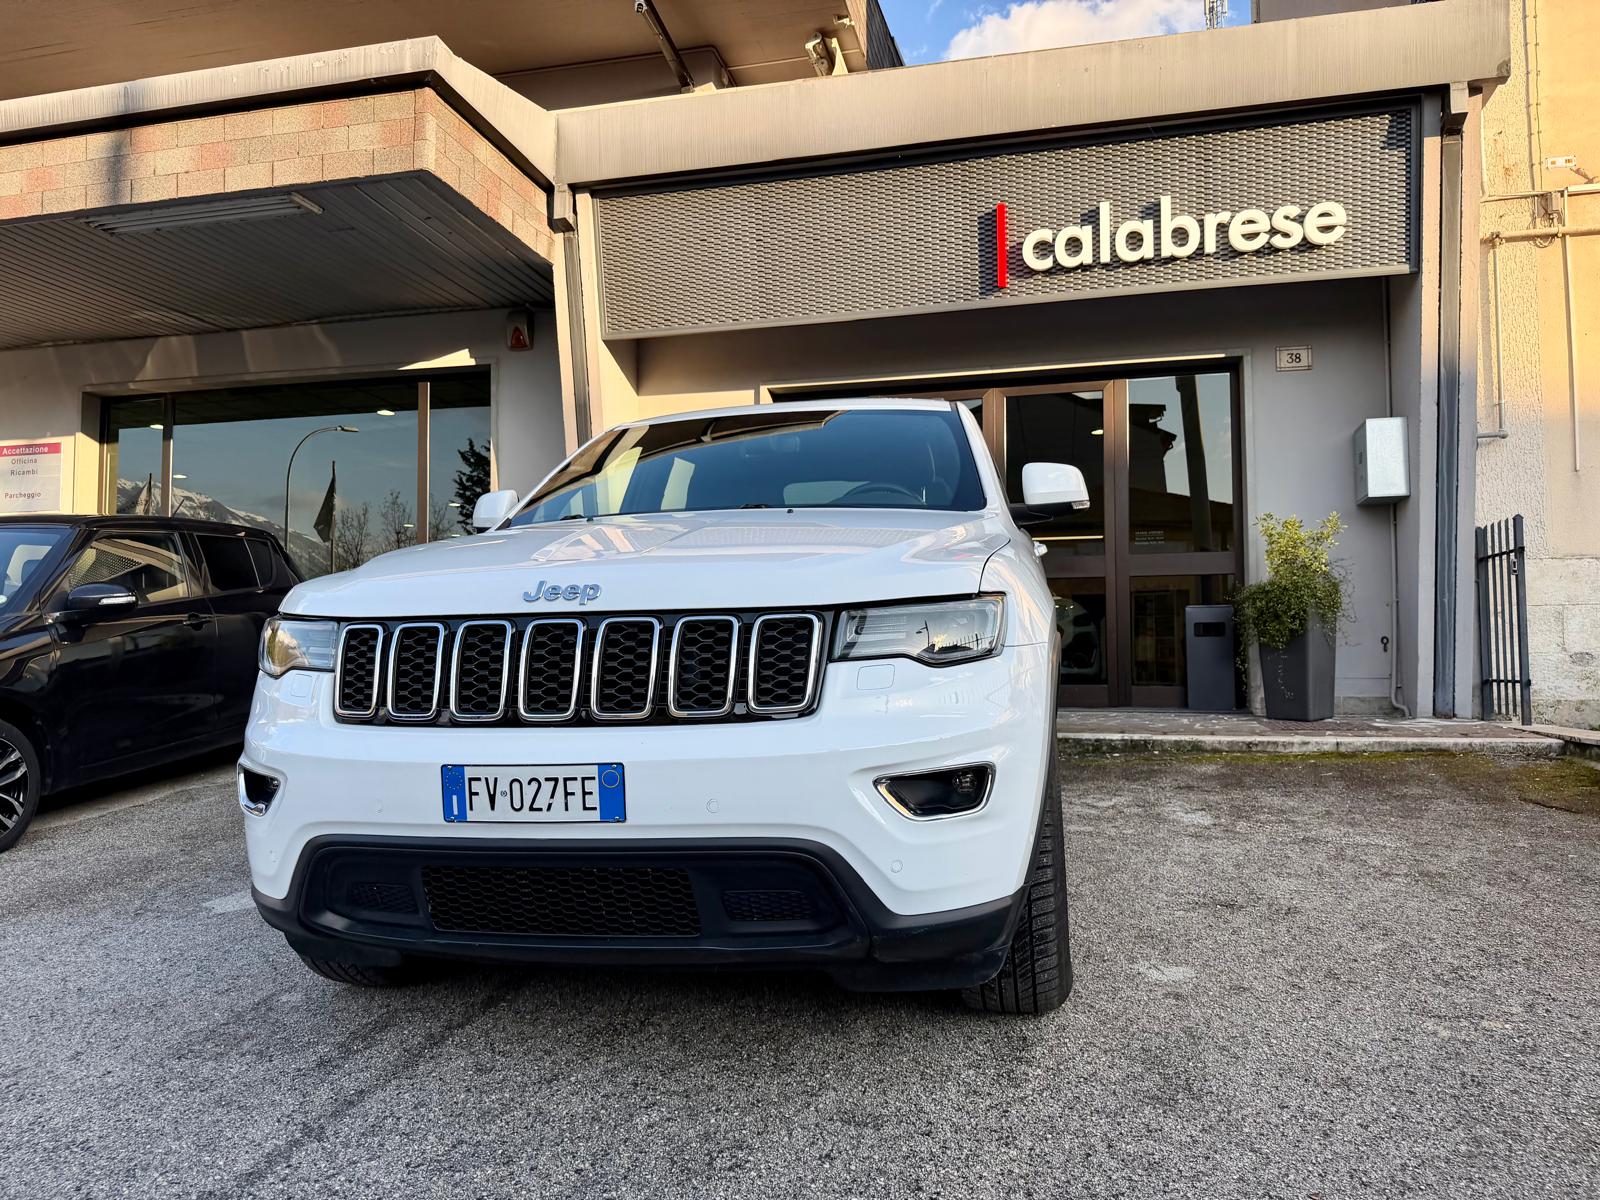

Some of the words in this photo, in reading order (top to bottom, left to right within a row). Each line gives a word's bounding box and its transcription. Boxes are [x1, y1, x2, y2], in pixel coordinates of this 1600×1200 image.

[1022, 195, 1347, 272] calabrese
[1286, 352, 1302, 364] 38
[2, 447, 49, 456] Accettazione
[11, 457, 38, 465] Officina
[10, 469, 38, 477] Ricambi
[4, 491, 42, 500] Parcheggio
[523, 580, 601, 606] Jeep
